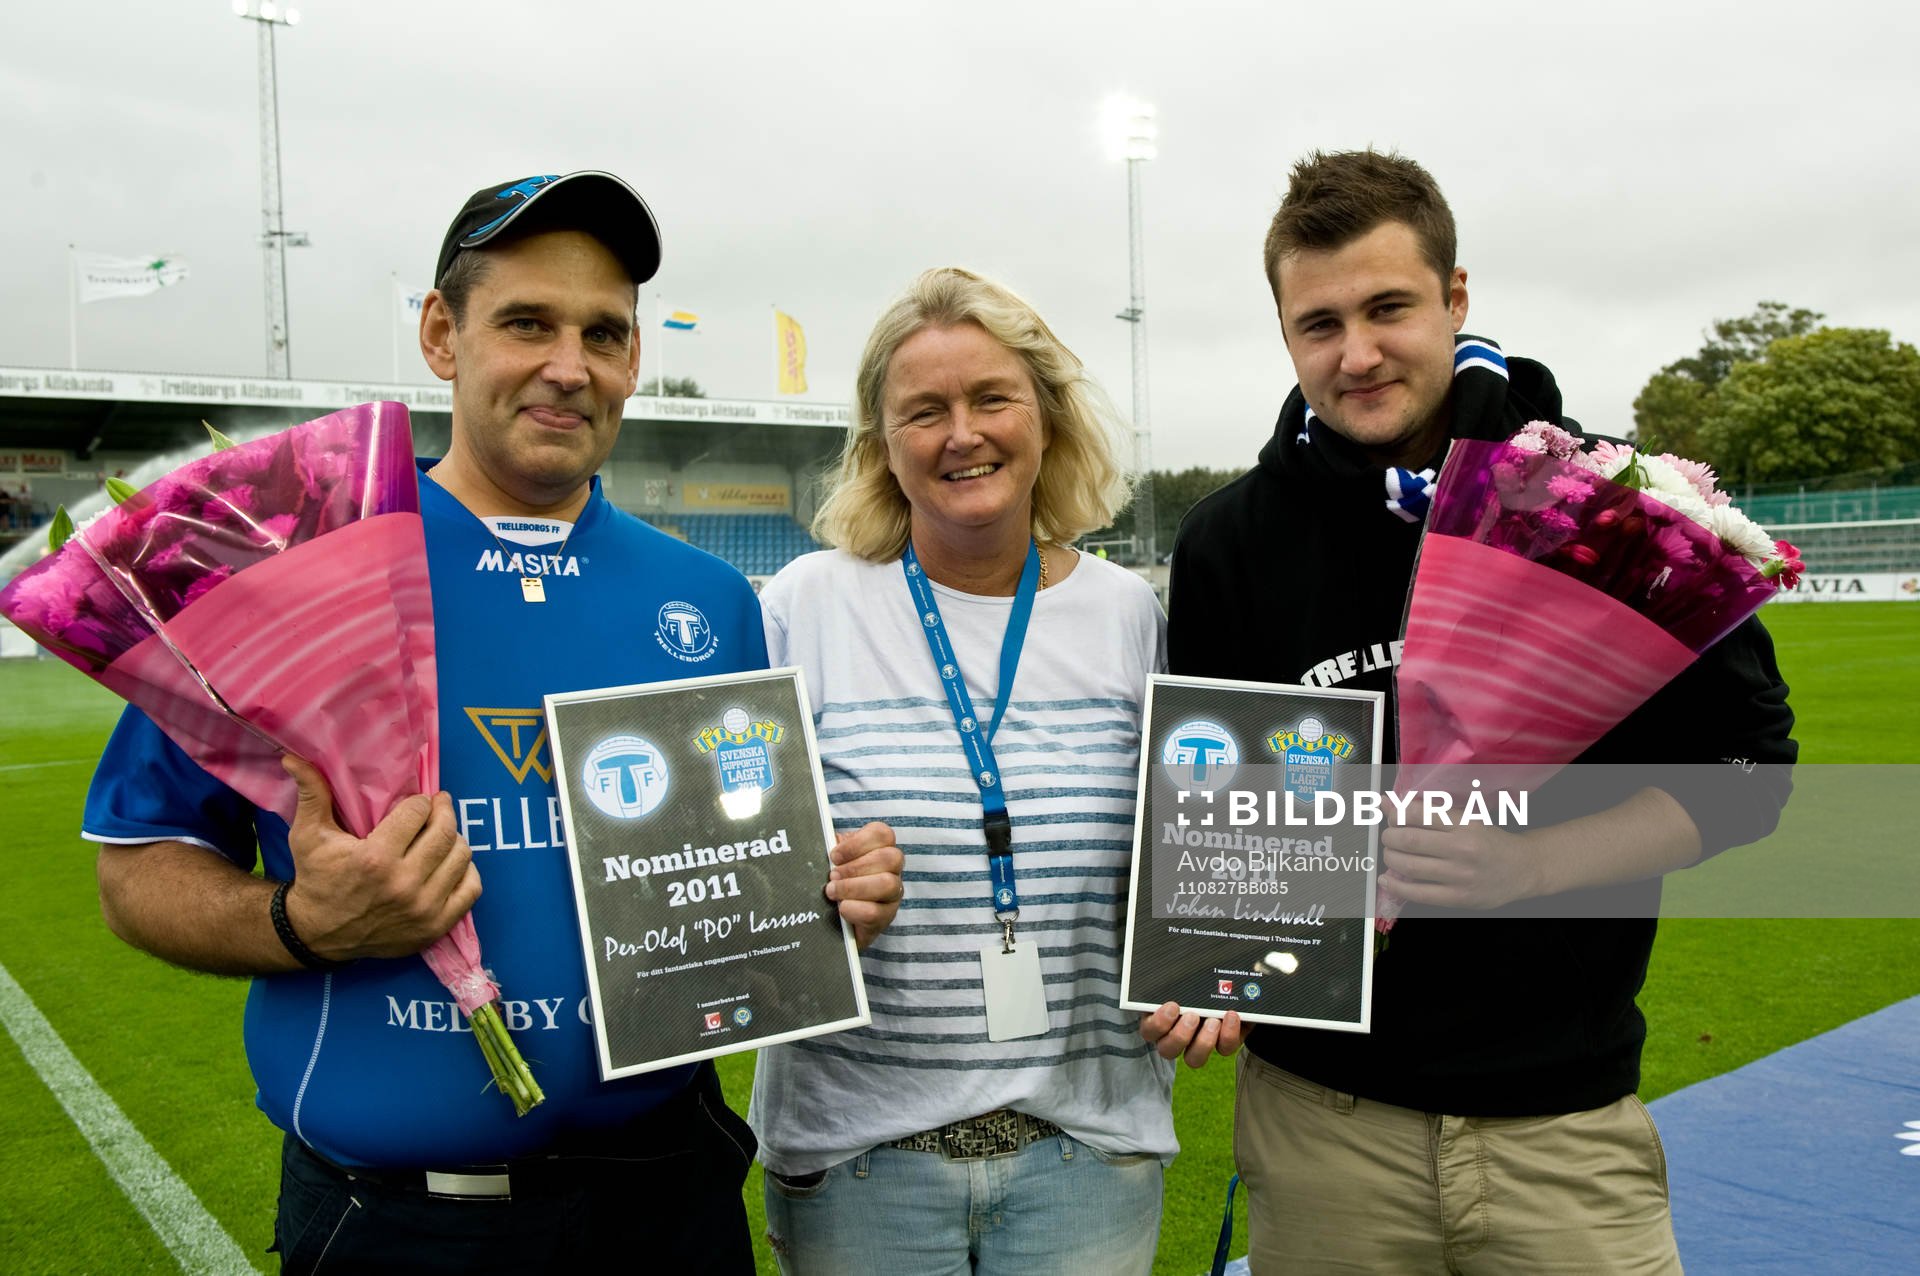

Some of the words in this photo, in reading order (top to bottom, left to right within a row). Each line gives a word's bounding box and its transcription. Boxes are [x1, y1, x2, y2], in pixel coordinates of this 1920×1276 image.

[496, 522, 550, 533] TRELLEBORGS
[551, 525, 561, 534] FF
[475, 549, 580, 577] MASITA
[653, 630, 715, 662] TRELLEBORGS
[720, 746, 765, 762] SVENSKA
[1288, 754, 1330, 765] SVENSKA
[721, 757, 768, 771] SUPPORTER
[1287, 764, 1330, 775] SUPPORTER
[727, 766, 765, 783] LAGET
[1290, 773, 1327, 786] LAGET
[1161, 822, 1334, 858] Nominerad
[602, 829, 791, 882] Nominerad
[1211, 859, 1278, 885] 2011
[666, 872, 741, 907] 2011
[1165, 892, 1226, 918] Johan
[1233, 897, 1326, 927] Lindwall
[604, 925, 688, 961] Per-Olof
[749, 911, 820, 935] Larsson
[1180, 927, 1192, 935] ditt
[1193, 928, 1228, 938] fantastiska
[1229, 931, 1270, 942] engagemang
[1275, 935, 1311, 945] Trelleborgs
[1312, 938, 1322, 946] FF
[636, 970, 649, 978] För
[650, 968, 663, 977] ditt
[664, 961, 703, 974] fantastiska
[704, 952, 748, 966] engagemang
[752, 944, 791, 956] Trelleborgs
[791, 941, 801, 949] FF
[1217, 968, 1249, 976] samarbete
[700, 995, 735, 1008] samarbete
[735, 993, 750, 1001] med
